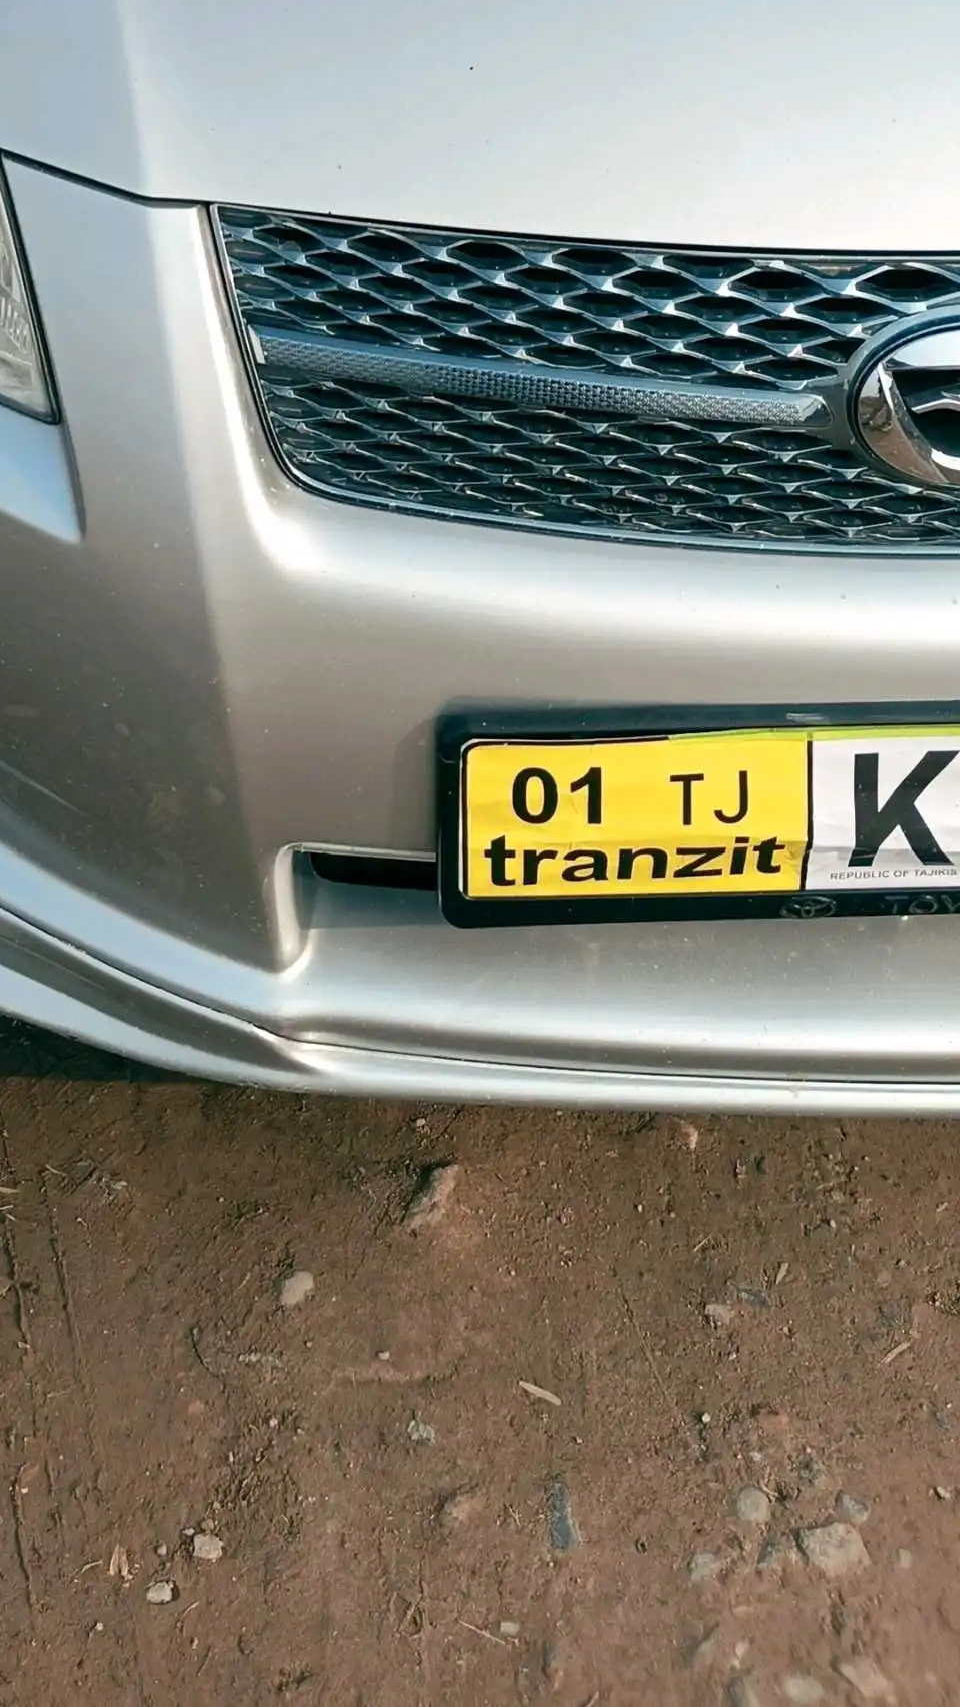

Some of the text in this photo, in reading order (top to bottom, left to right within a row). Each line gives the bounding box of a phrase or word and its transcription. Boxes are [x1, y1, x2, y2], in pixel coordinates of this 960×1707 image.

[511, 766, 749, 826] 01 TJ
[483, 834, 786, 887] tranzit
[830, 870, 890, 880] REPUBLIC
[893, 870, 908, 878] OF
